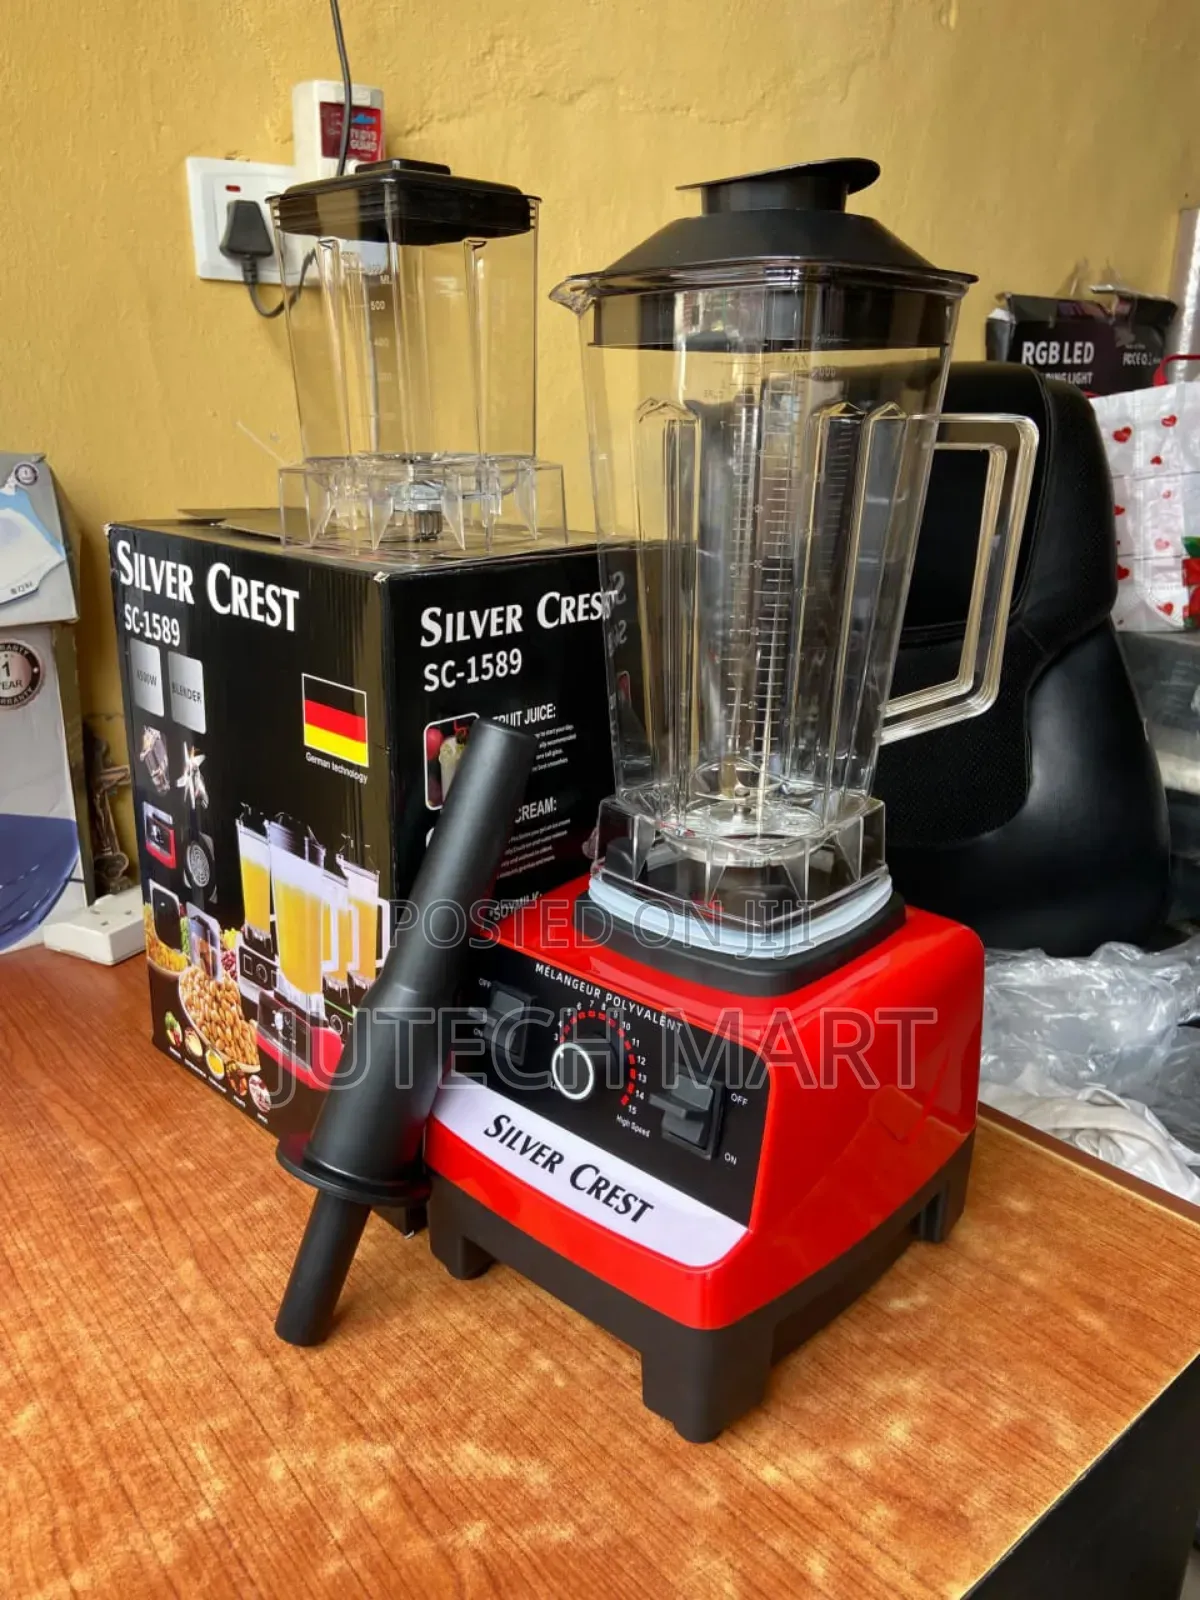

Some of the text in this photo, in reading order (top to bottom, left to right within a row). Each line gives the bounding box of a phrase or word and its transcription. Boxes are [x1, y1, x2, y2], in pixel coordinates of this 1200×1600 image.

[370, 300, 385, 311] 500
[1021, 340, 1061, 366] RGB
[1062, 340, 1095, 365] LED
[1067, 371, 1094, 385] LIGHT
[116, 540, 300, 632] SILVER CREST
[124, 604, 181, 647] SC-1589
[420, 589, 619, 648] SILVER CREST
[2, 661, 10, 677] 1
[423, 647, 523, 692] SC-1589
[0, 679, 23, 690] EAR
[171, 680, 202, 704] BLENDER
[524, 702, 556, 725] JUICE:
[305, 751, 368, 786] German technology
[534, 962, 684, 1034] MÉLANGEUR POLYVALENT
[589, 999, 595, 1008] 7
[622, 1020, 632, 1031] 10
[632, 1037, 641, 1048] 11
[637, 1055, 647, 1066] 12
[638, 1072, 648, 1083] 13
[635, 1089, 645, 1101] 14
[730, 1092, 748, 1106] OFF
[628, 1104, 638, 1116] 15
[616, 1113, 651, 1138] High Speed
[724, 1151, 737, 1165] ON
[483, 1114, 655, 1223] SILVER CREST
